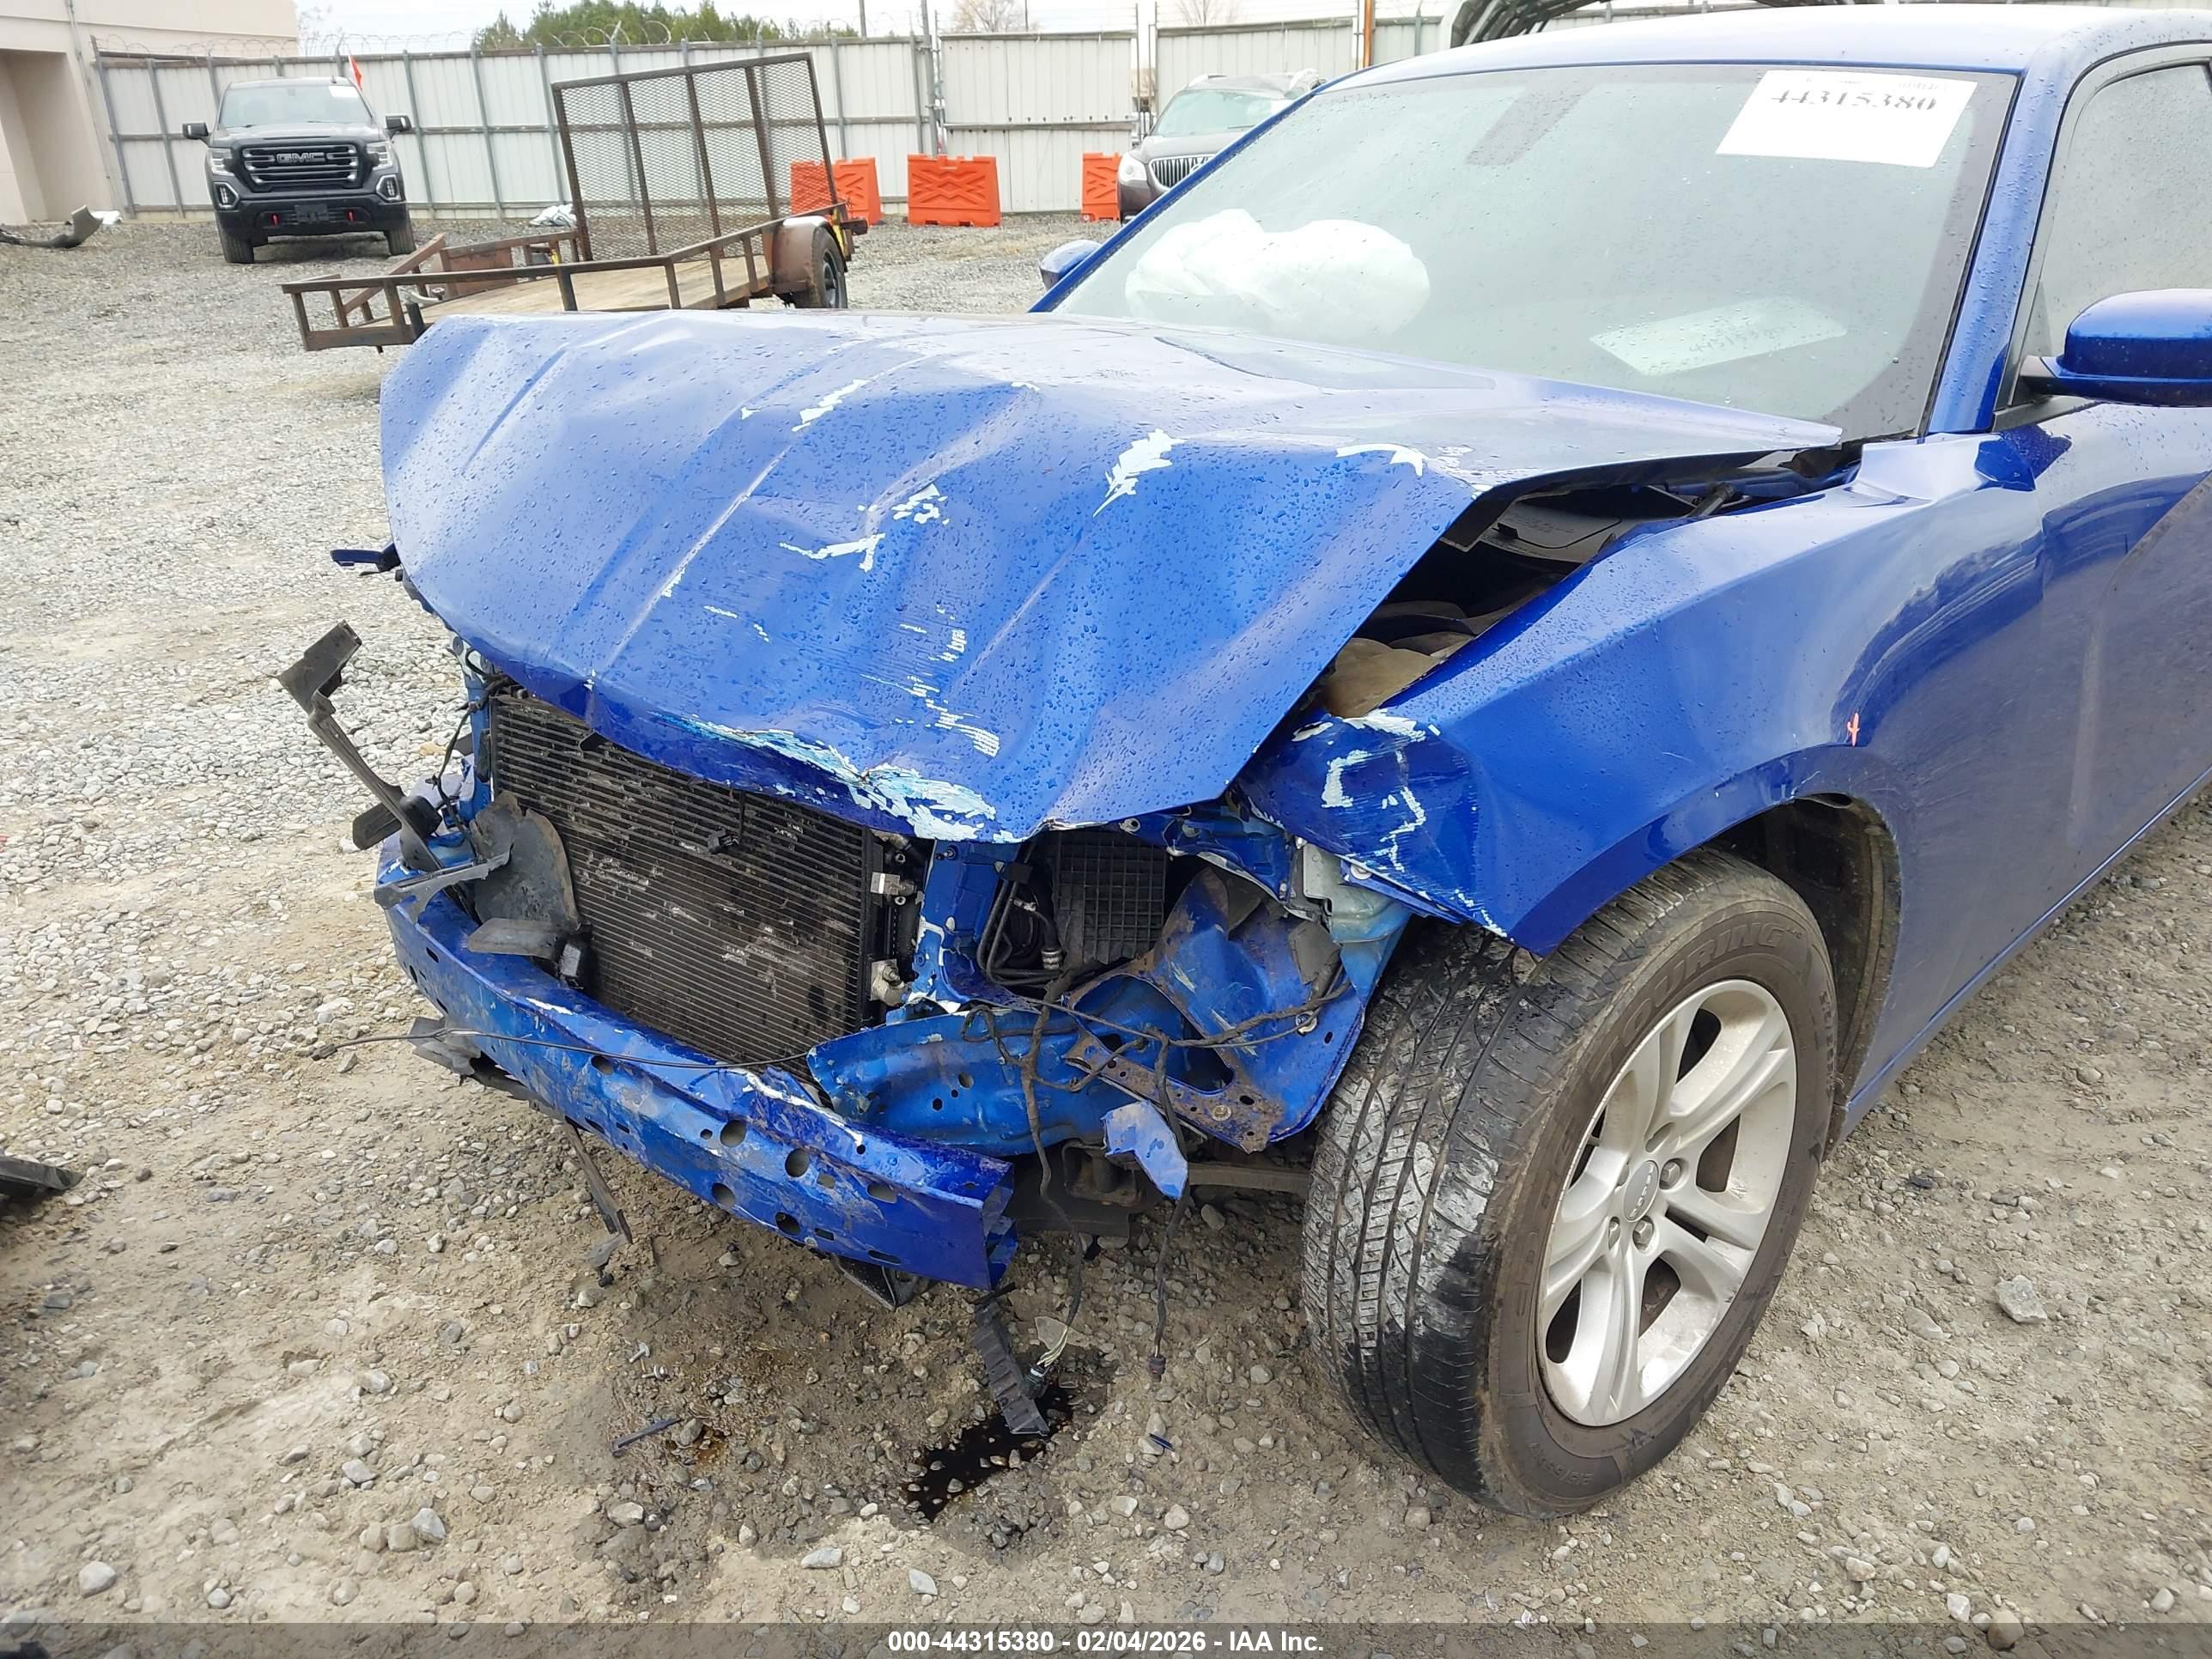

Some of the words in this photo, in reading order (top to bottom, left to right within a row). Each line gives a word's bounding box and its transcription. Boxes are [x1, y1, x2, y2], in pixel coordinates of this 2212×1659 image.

[1771, 89, 1937, 111] 44315380
[276, 152, 325, 163] GMC
[1587, 921, 1785, 1082] TOURING
